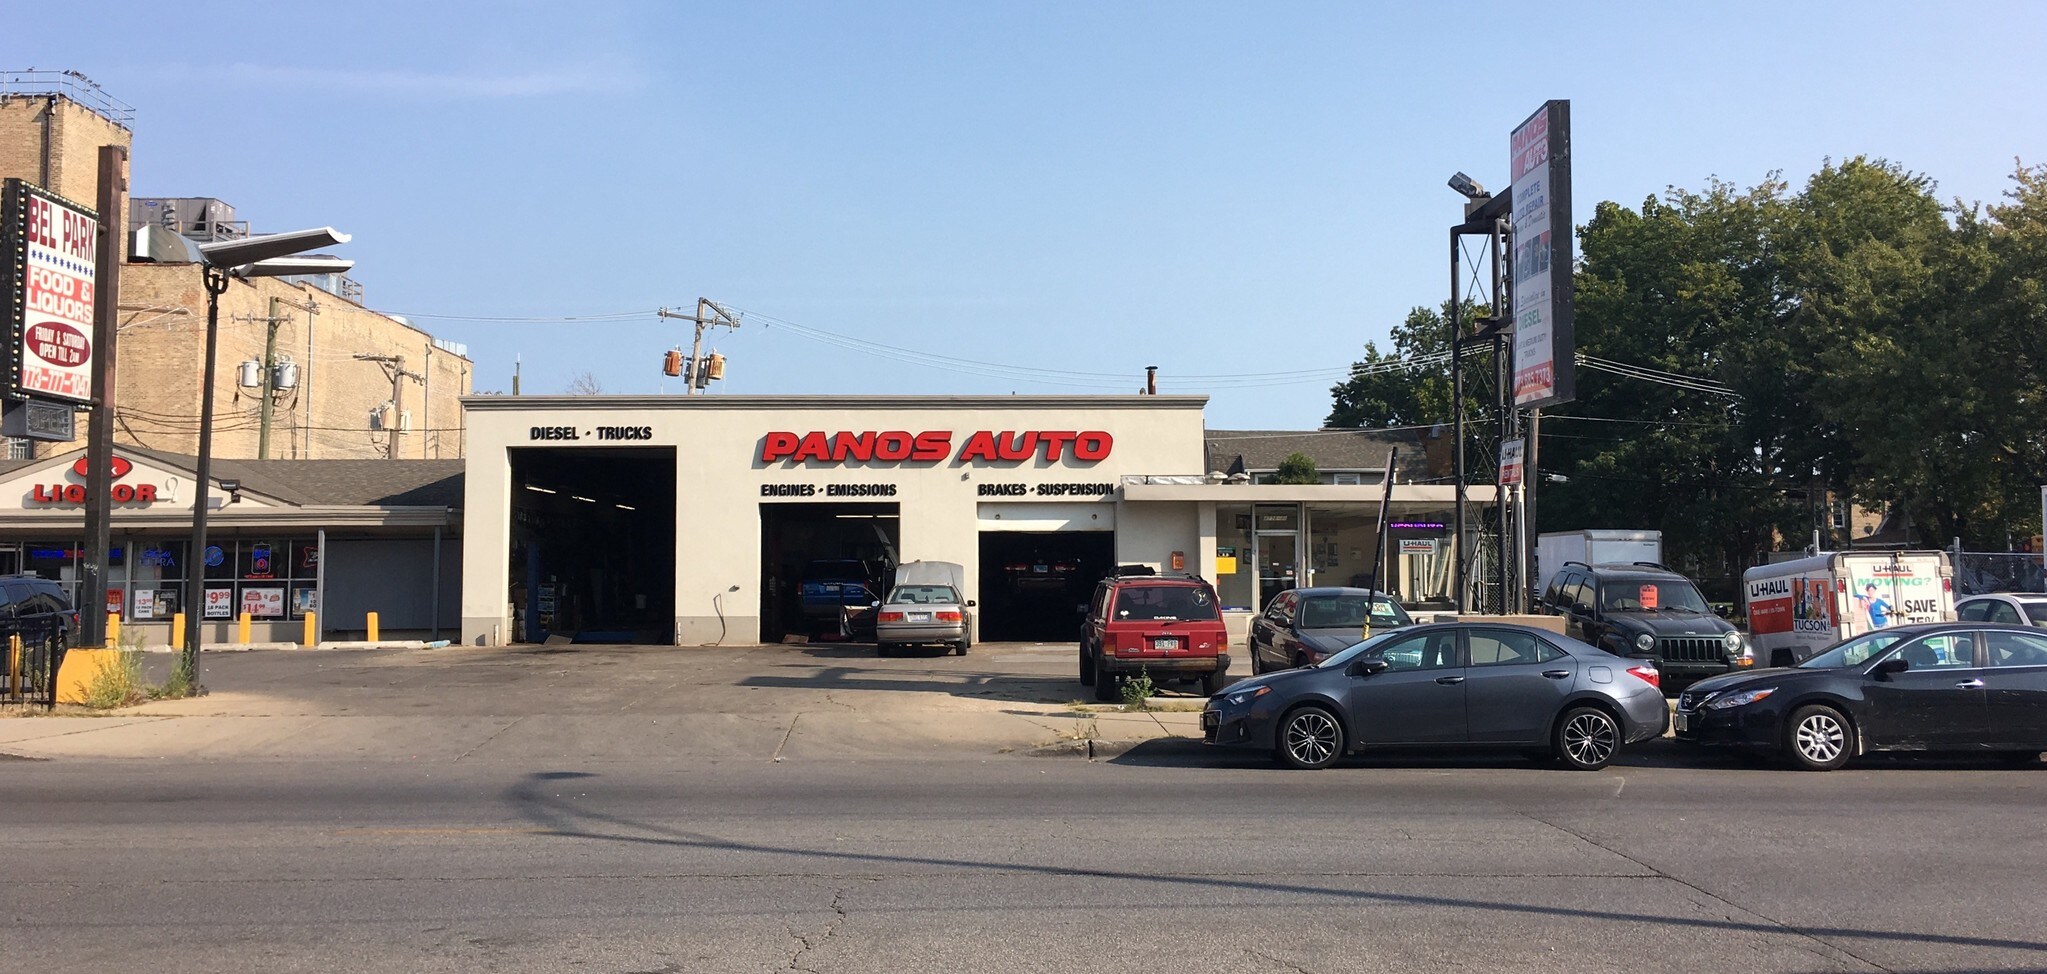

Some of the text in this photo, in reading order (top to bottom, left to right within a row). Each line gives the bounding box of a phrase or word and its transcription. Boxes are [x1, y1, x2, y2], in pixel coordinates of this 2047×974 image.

[1513, 111, 1547, 152] PANOS
[1524, 138, 1548, 174] AUTO
[29, 197, 95, 263] BEL PARK
[30, 265, 92, 302] FOOD &
[26, 287, 93, 325] LIQUORS
[1518, 309, 1541, 330] DIESEL
[35, 326, 54, 343] FRIDAY
[62, 332, 85, 350] SATURDAY
[39, 342, 57, 359] OPEN
[58, 346, 68, 362] TILL
[23, 365, 91, 397] 773-777-1047
[530, 426, 652, 440] DIESEL TRUCKS
[762, 430, 1114, 462] PANOS AUTO
[33, 484, 157, 504] LIQOR
[760, 484, 897, 496] ENGINES EMISSIONS
[977, 483, 1114, 496] BRAKES SUSPENSION
[1751, 580, 1789, 597] U-HAUL
[1904, 599, 1937, 613] SAVE
[1794, 620, 1827, 632] TUCSON
